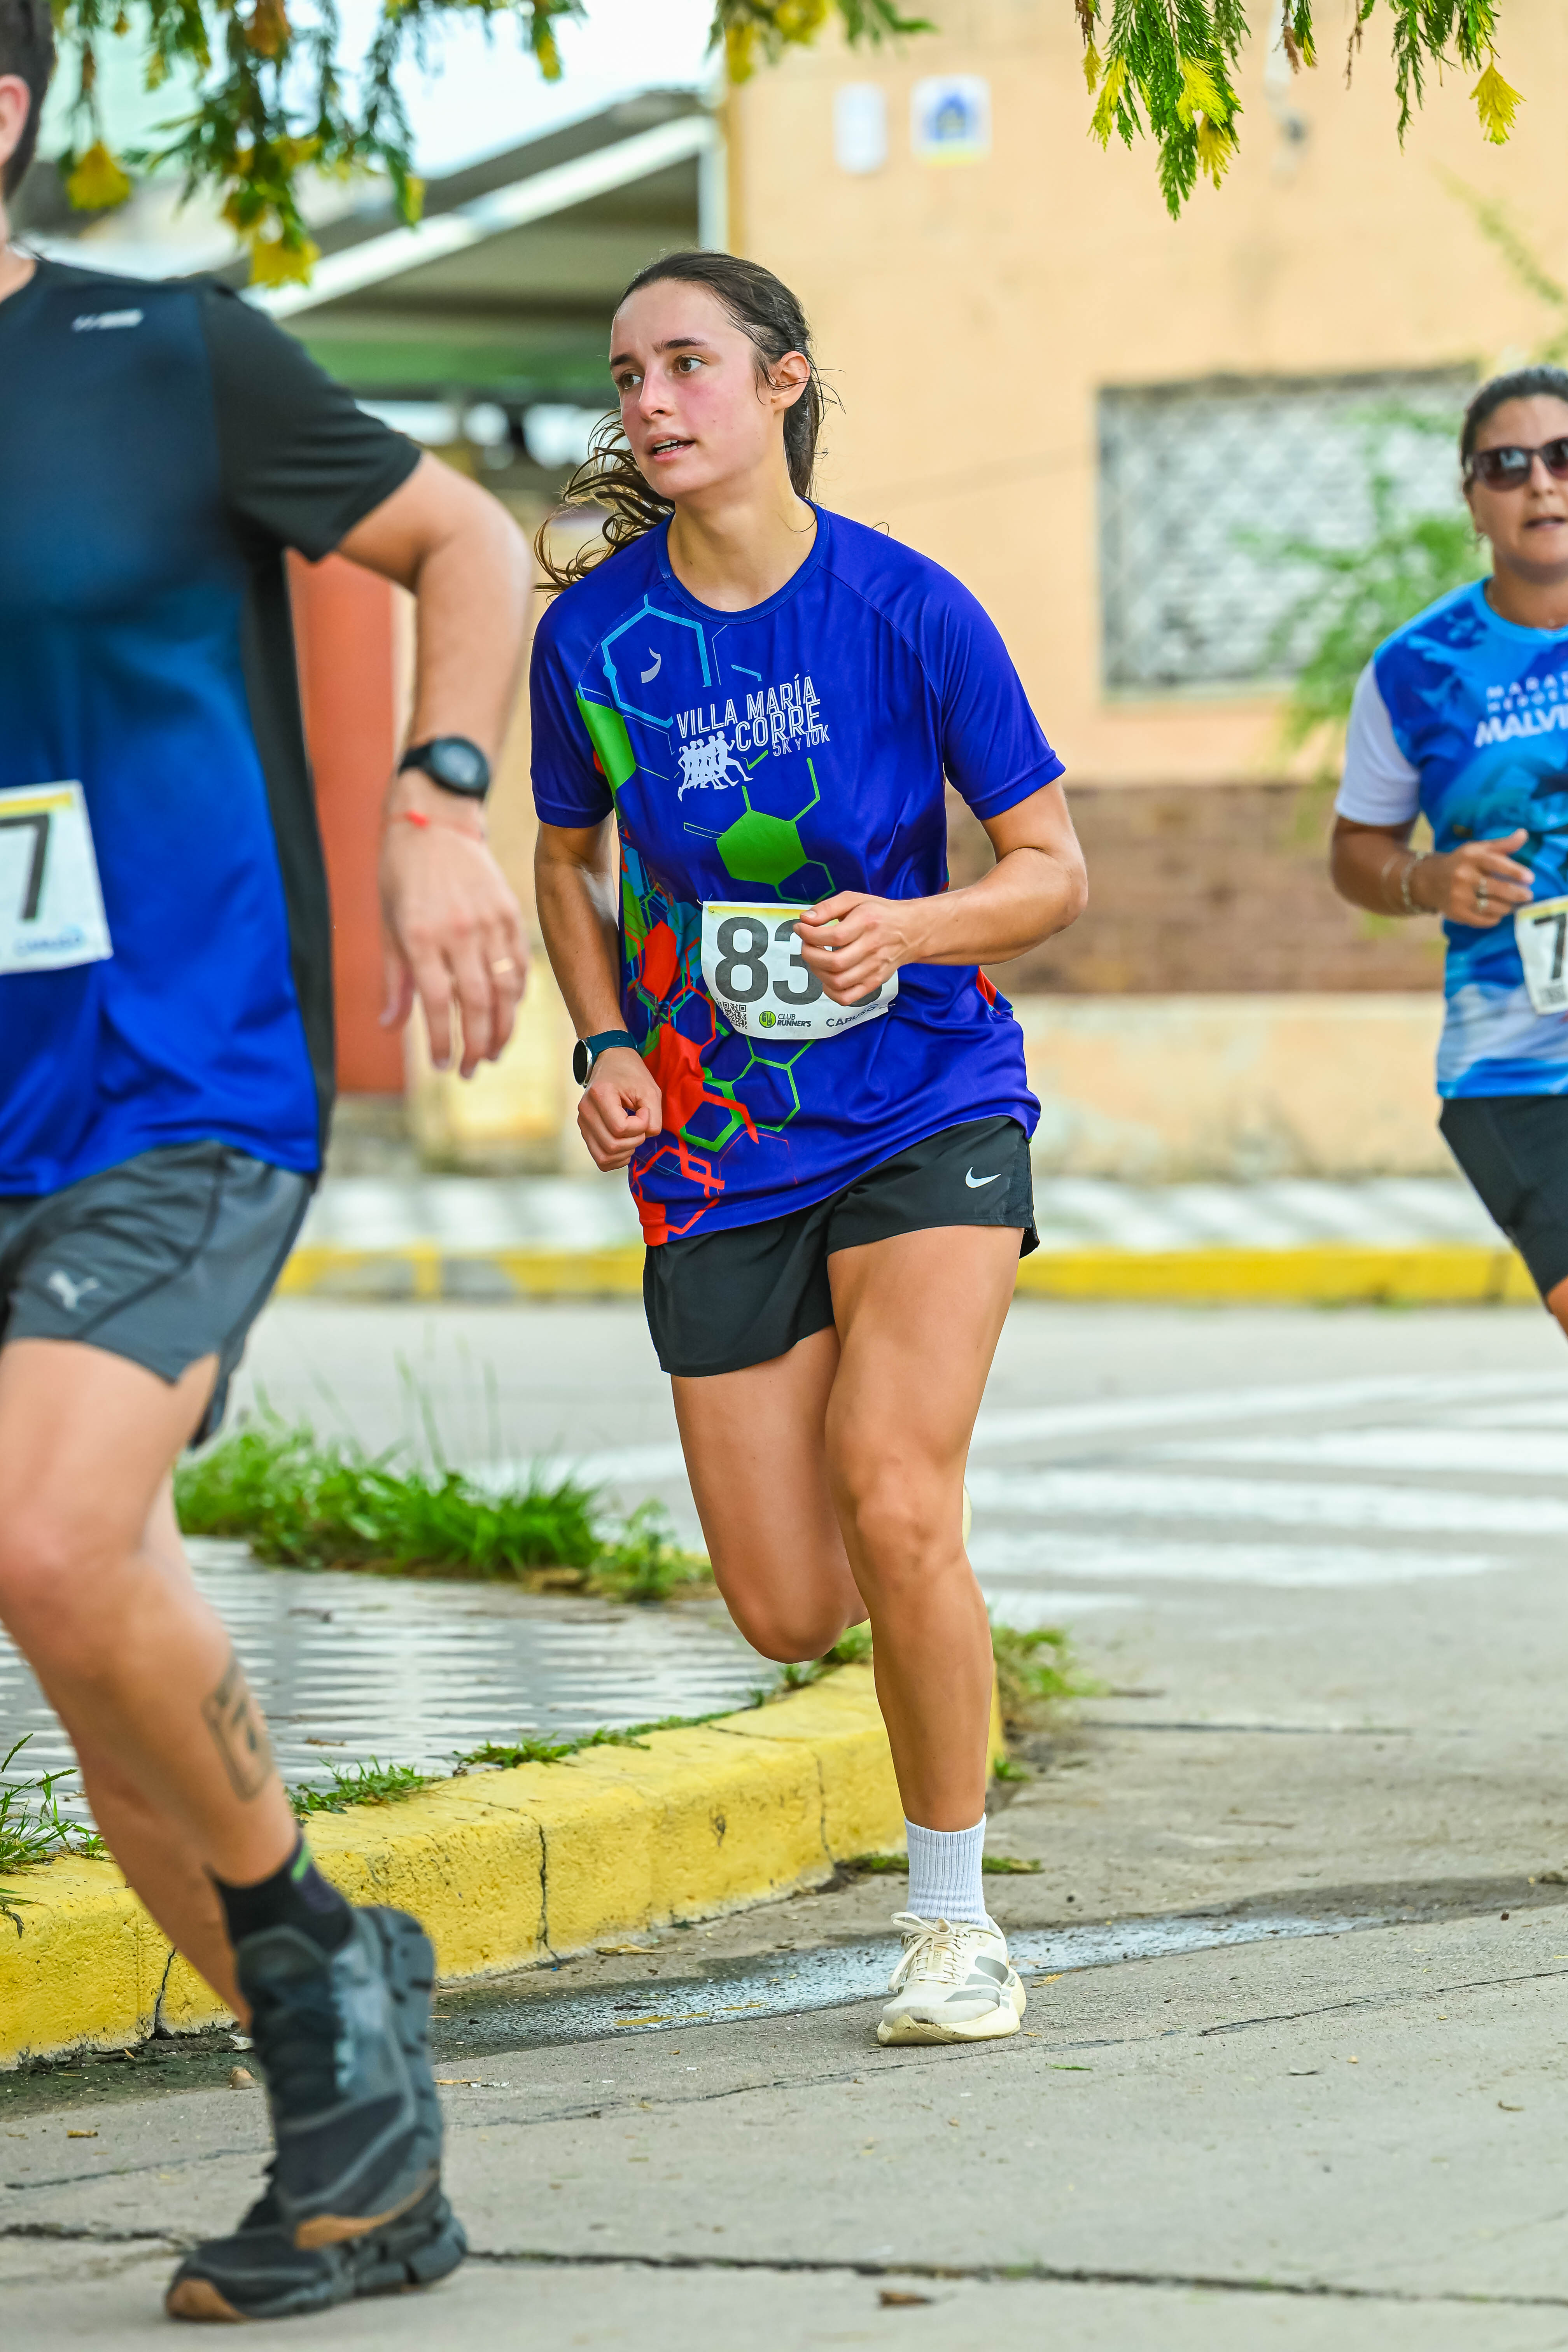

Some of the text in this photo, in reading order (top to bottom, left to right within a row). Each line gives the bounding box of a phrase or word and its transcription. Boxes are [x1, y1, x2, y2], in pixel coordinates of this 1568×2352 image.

[676, 673, 817, 738] VILLA MARÍA
[735, 698, 823, 752] CORRE
[1474, 703, 1568, 747] MALVI
[772, 736, 792, 757] 5K
[804, 724, 830, 747] 10K
[715, 917, 882, 1007] 83
[826, 1006, 876, 1027] CARUSO
